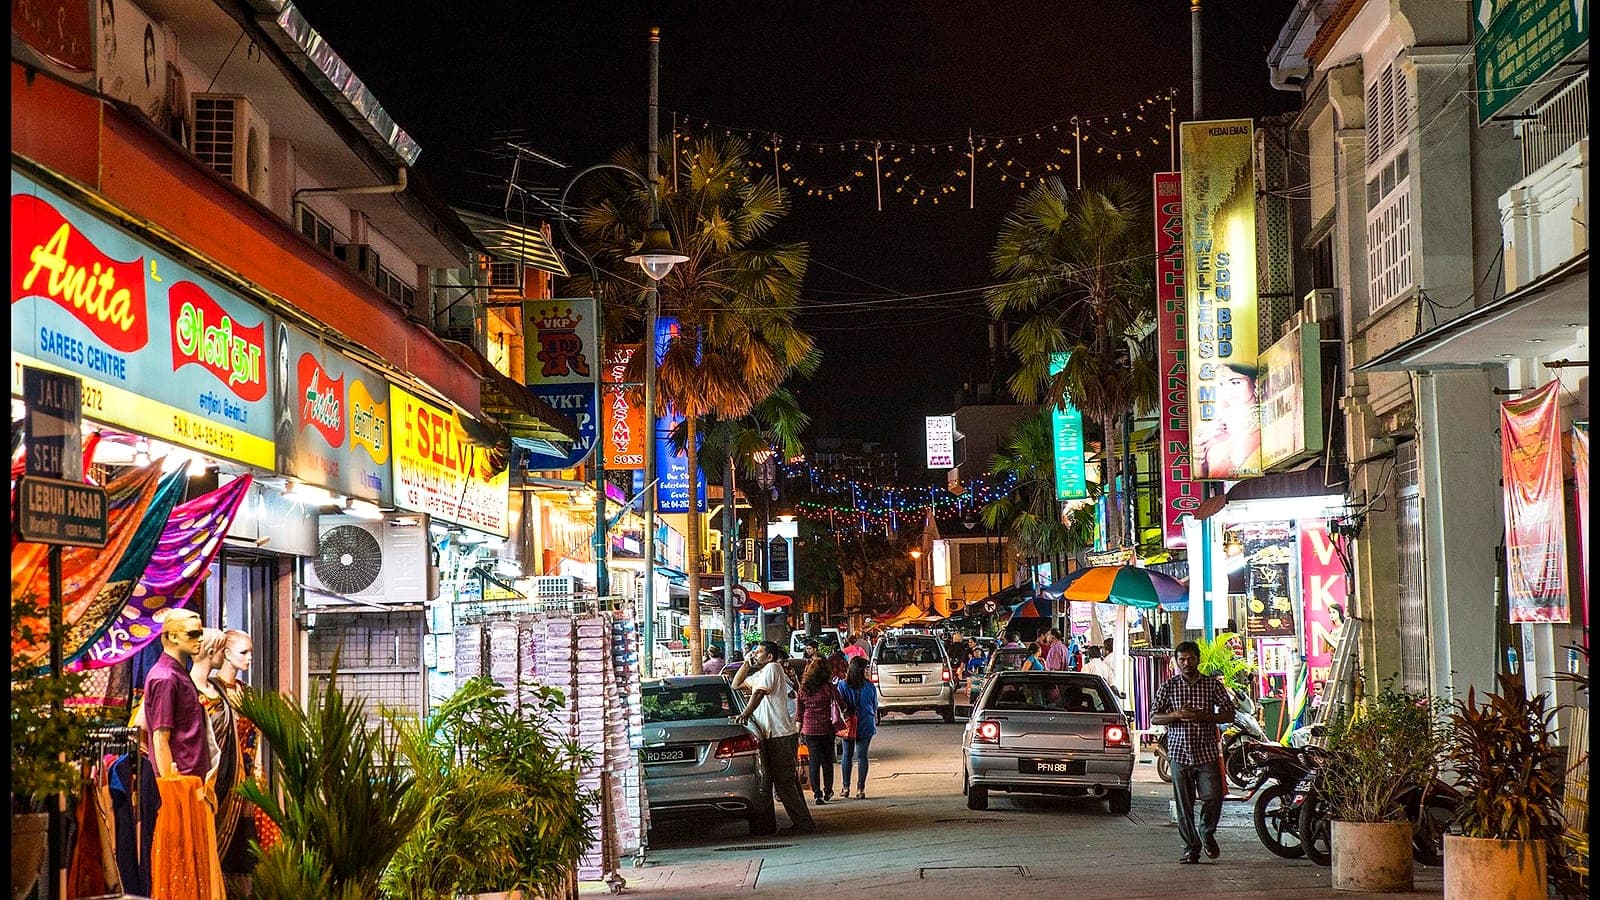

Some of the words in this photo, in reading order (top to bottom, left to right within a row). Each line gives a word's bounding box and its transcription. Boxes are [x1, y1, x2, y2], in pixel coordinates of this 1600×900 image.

[1208, 128, 1229, 137] KEDAI
[1230, 126, 1249, 135] EMAS
[22, 223, 136, 332] Anita
[1215, 252, 1231, 302] SDN
[543, 318, 571, 329] VKP
[1216, 307, 1233, 358] BHD
[40, 326, 84, 365] SAREES
[86, 345, 126, 380] CENTRE
[1198, 386, 1217, 421] MD
[614, 455, 643, 464] SONS
[28, 483, 65, 515] LEBUH
[68, 489, 101, 520] PASAR
[647, 752, 660, 761] RD
[660, 750, 684, 760] 5223
[1037, 763, 1054, 771] PFN
[1054, 763, 1067, 772] 881
